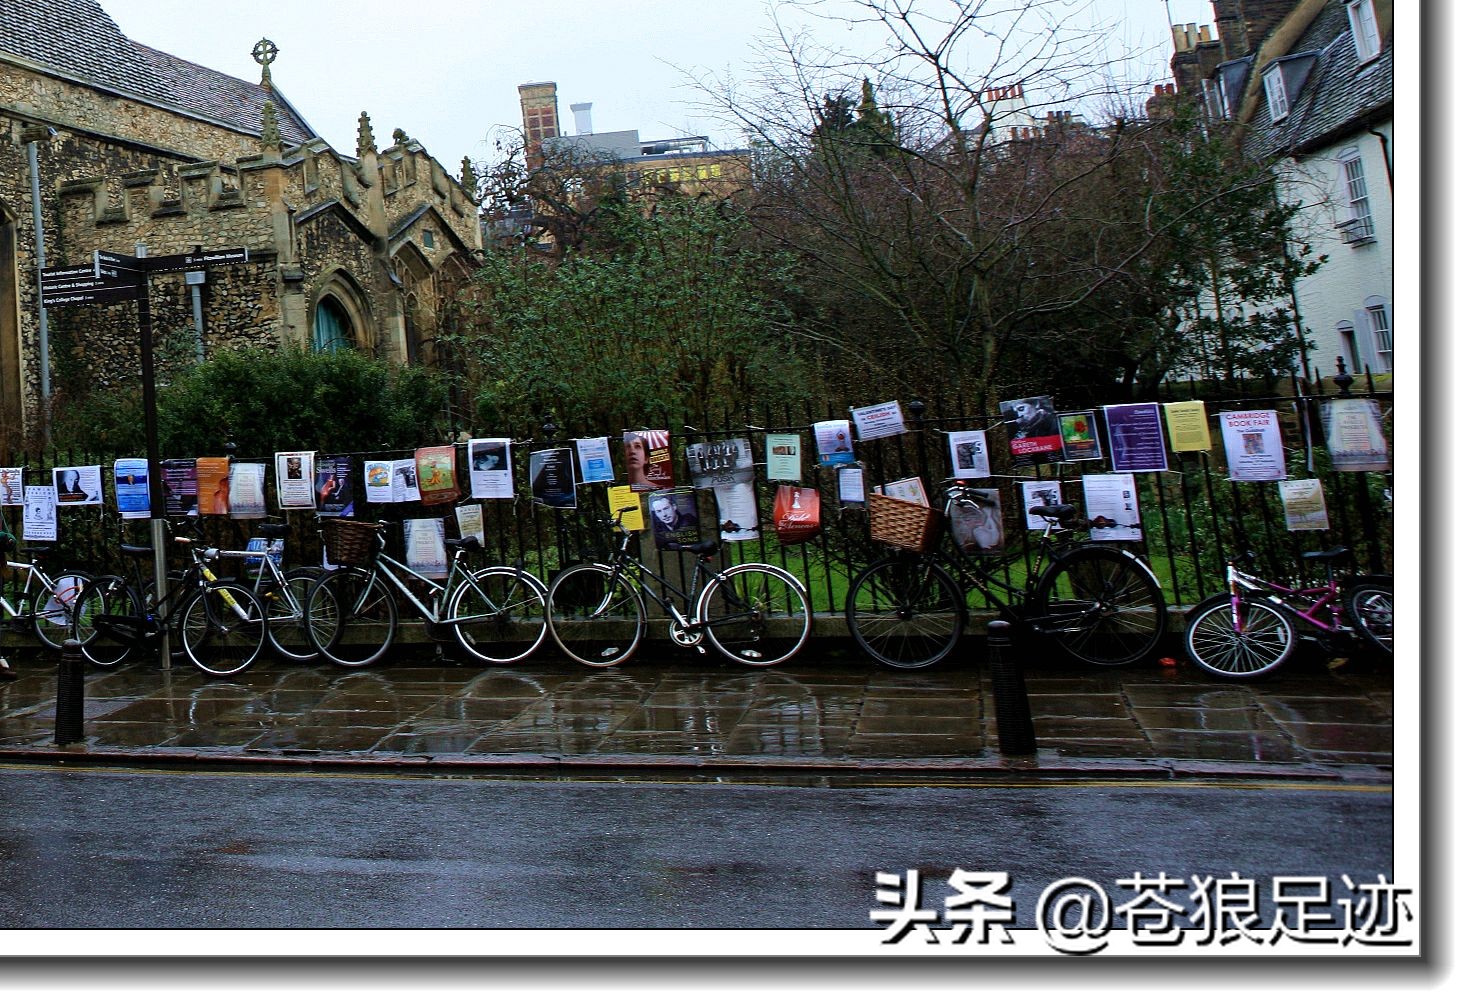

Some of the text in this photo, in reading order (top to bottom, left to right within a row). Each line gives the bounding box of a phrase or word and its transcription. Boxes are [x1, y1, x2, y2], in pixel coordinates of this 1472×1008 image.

[1226, 412, 1271, 420] CAMBRIDGE
[1228, 420, 1251, 428] BOOK
[664, 529, 699, 540] ENGLISH
[677, 536, 700, 544] SONG
